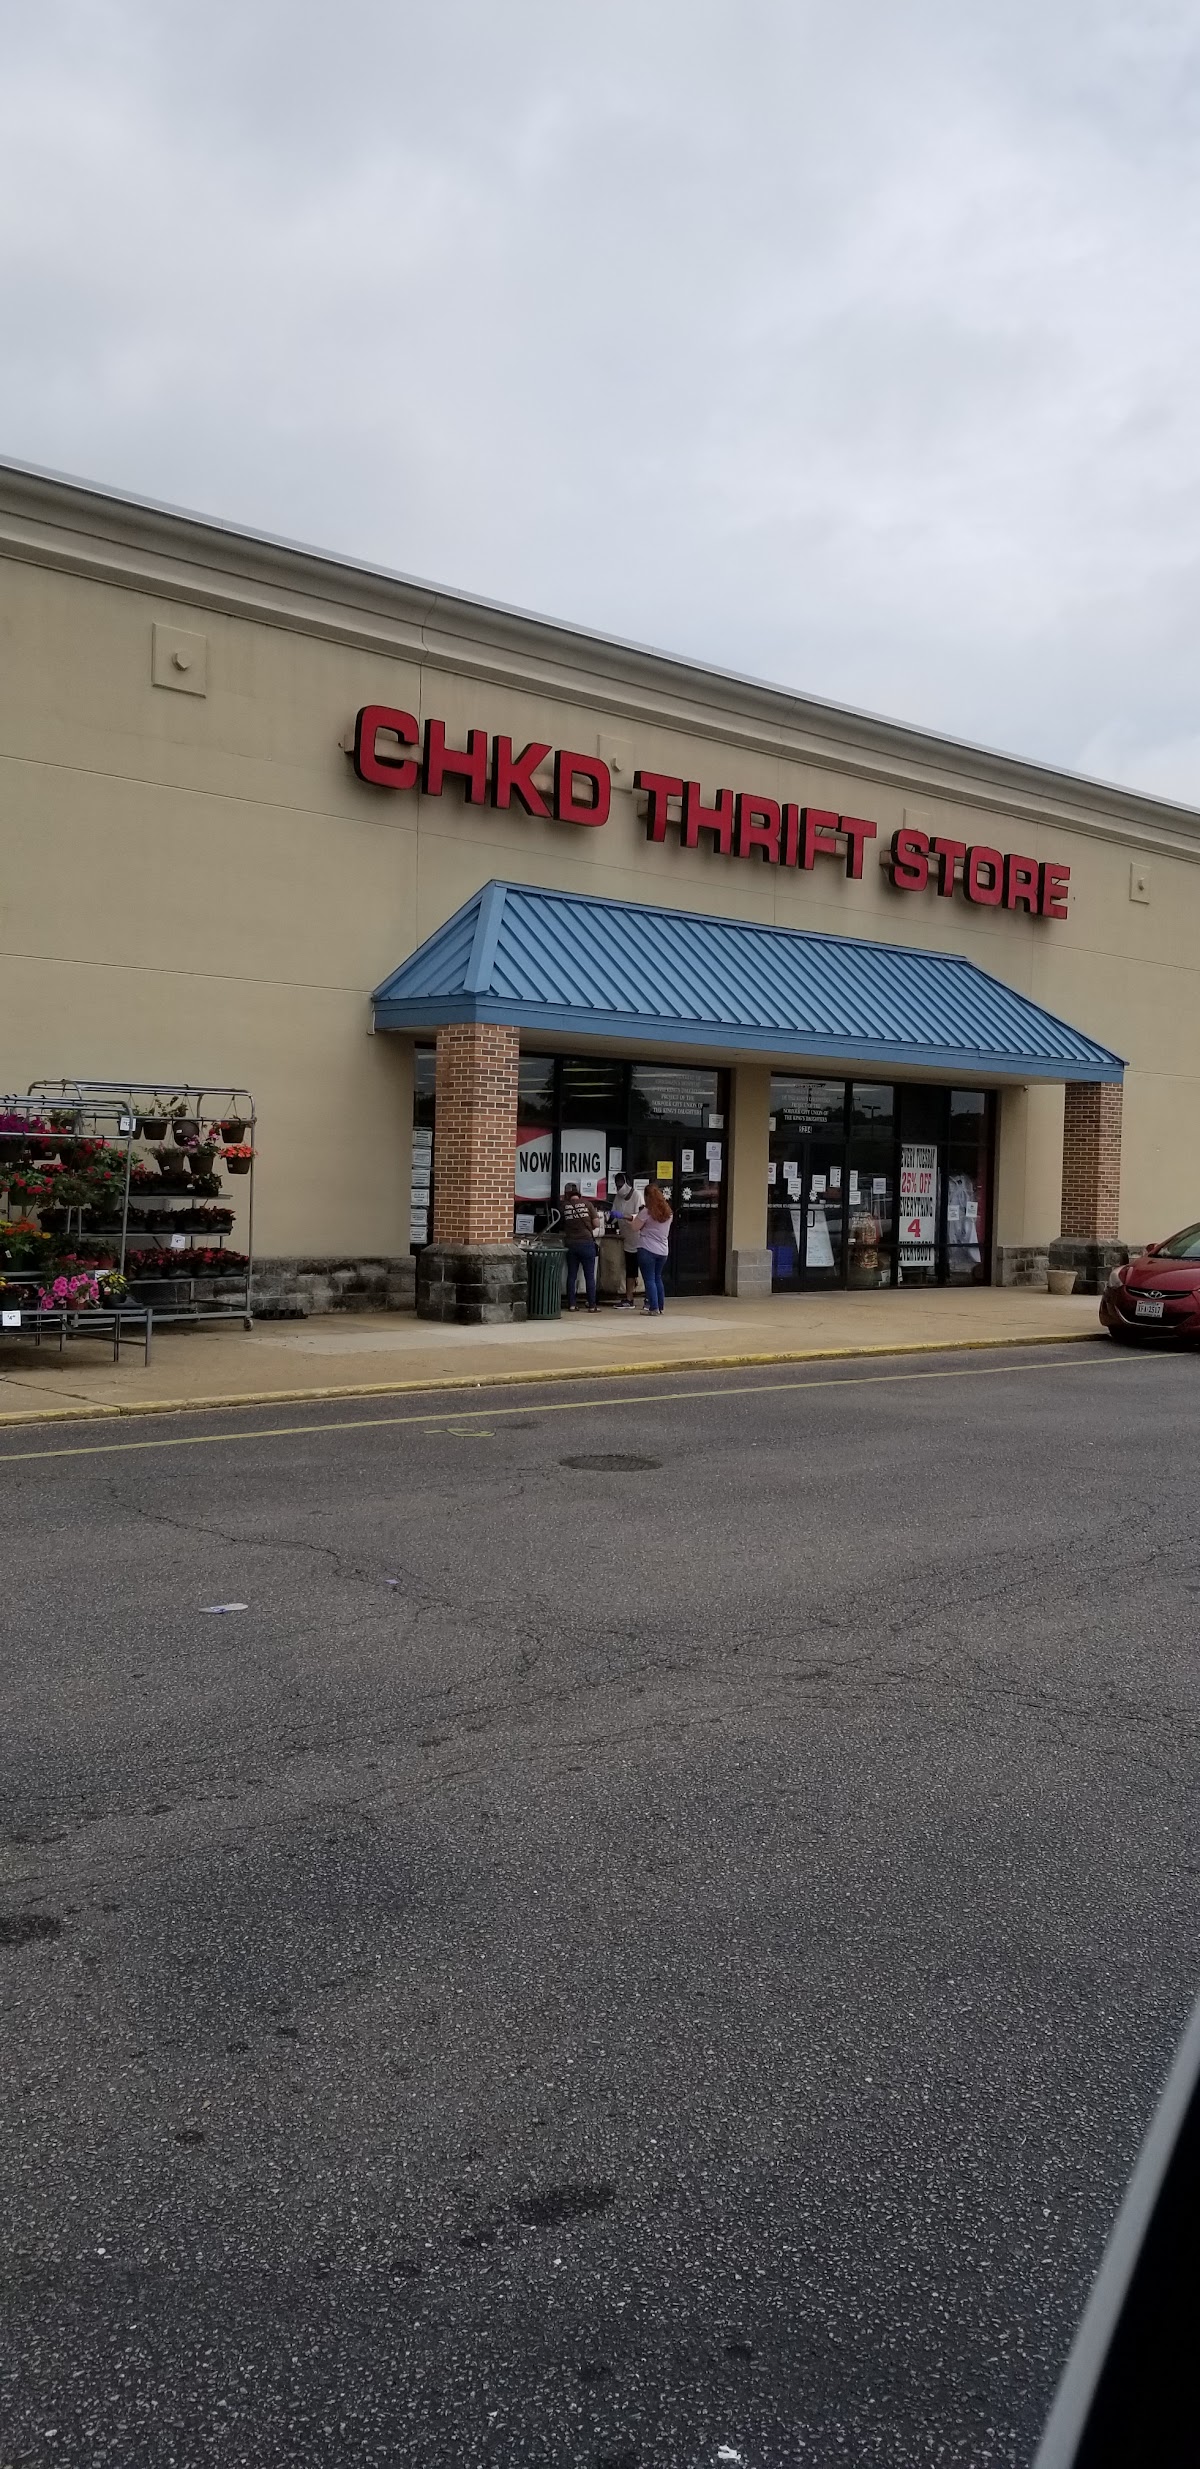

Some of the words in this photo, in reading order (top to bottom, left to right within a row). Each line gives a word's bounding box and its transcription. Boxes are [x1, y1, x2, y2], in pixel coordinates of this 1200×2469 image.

[354, 704, 611, 828] CHKD
[634, 769, 877, 880] THRIFT
[889, 828, 1071, 921] STORE
[520, 1151, 551, 1173] NOW
[901, 1147, 915, 1168] EVERY
[901, 1172, 917, 1193] 25%
[919, 1173, 932, 1194] OFF
[900, 1196, 933, 1217] EVERYTHING
[907, 1218, 921, 1238] 4
